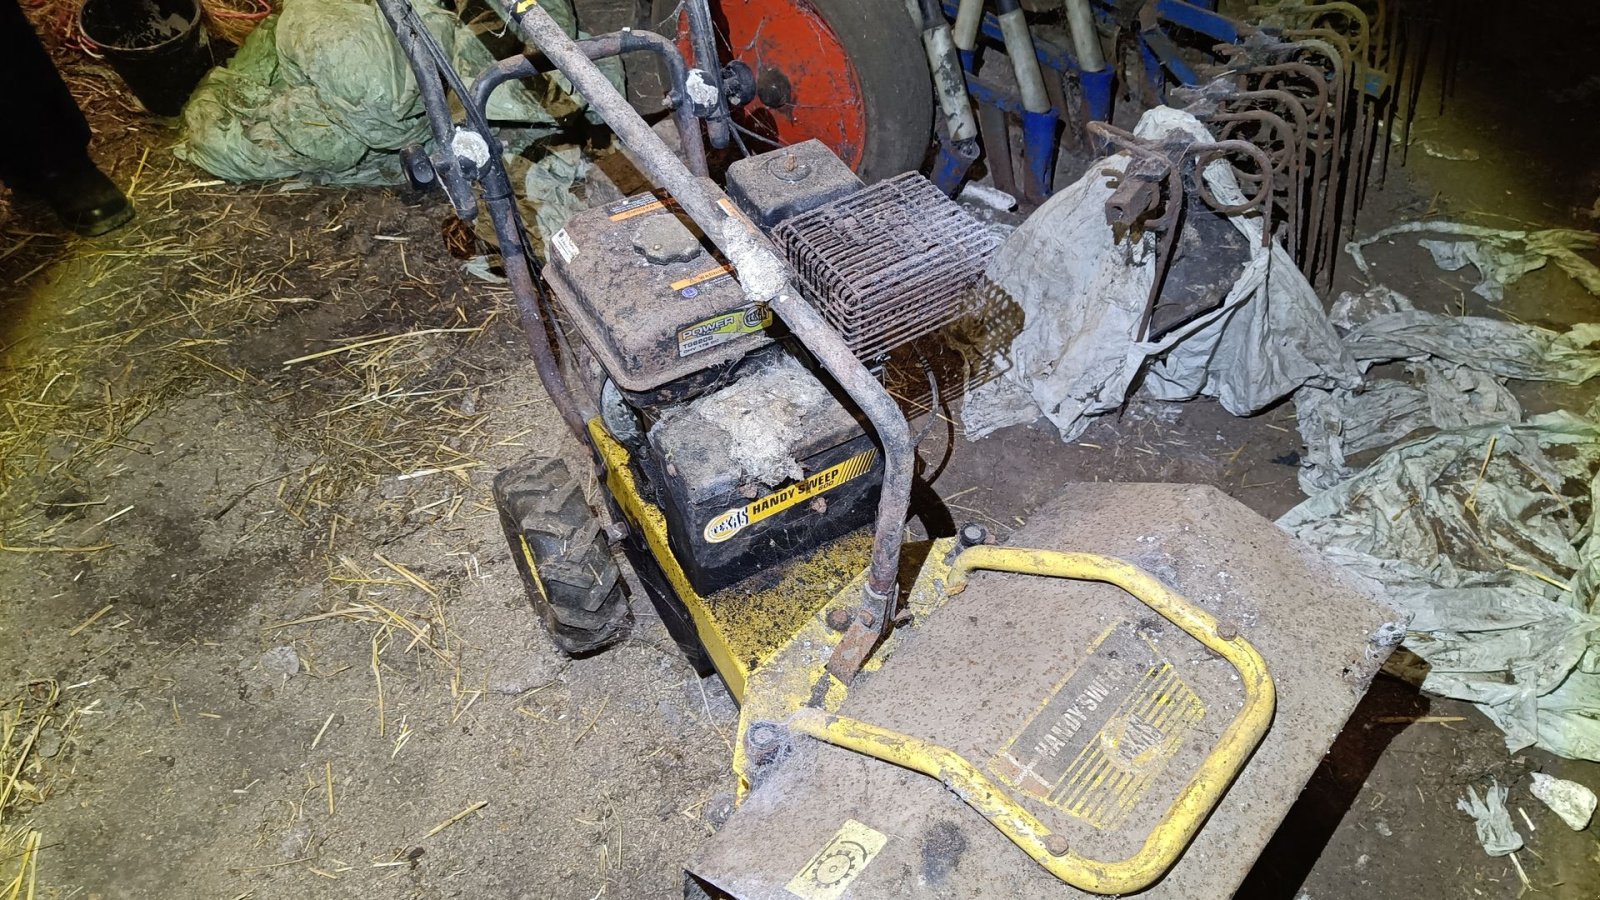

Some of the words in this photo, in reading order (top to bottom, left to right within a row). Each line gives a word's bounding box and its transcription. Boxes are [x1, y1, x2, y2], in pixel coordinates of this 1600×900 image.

[682, 316, 735, 341] POWER
[752, 488, 795, 515] HANDY
[797, 469, 839, 494] SWEEP
[1034, 703, 1087, 758] HANDY
